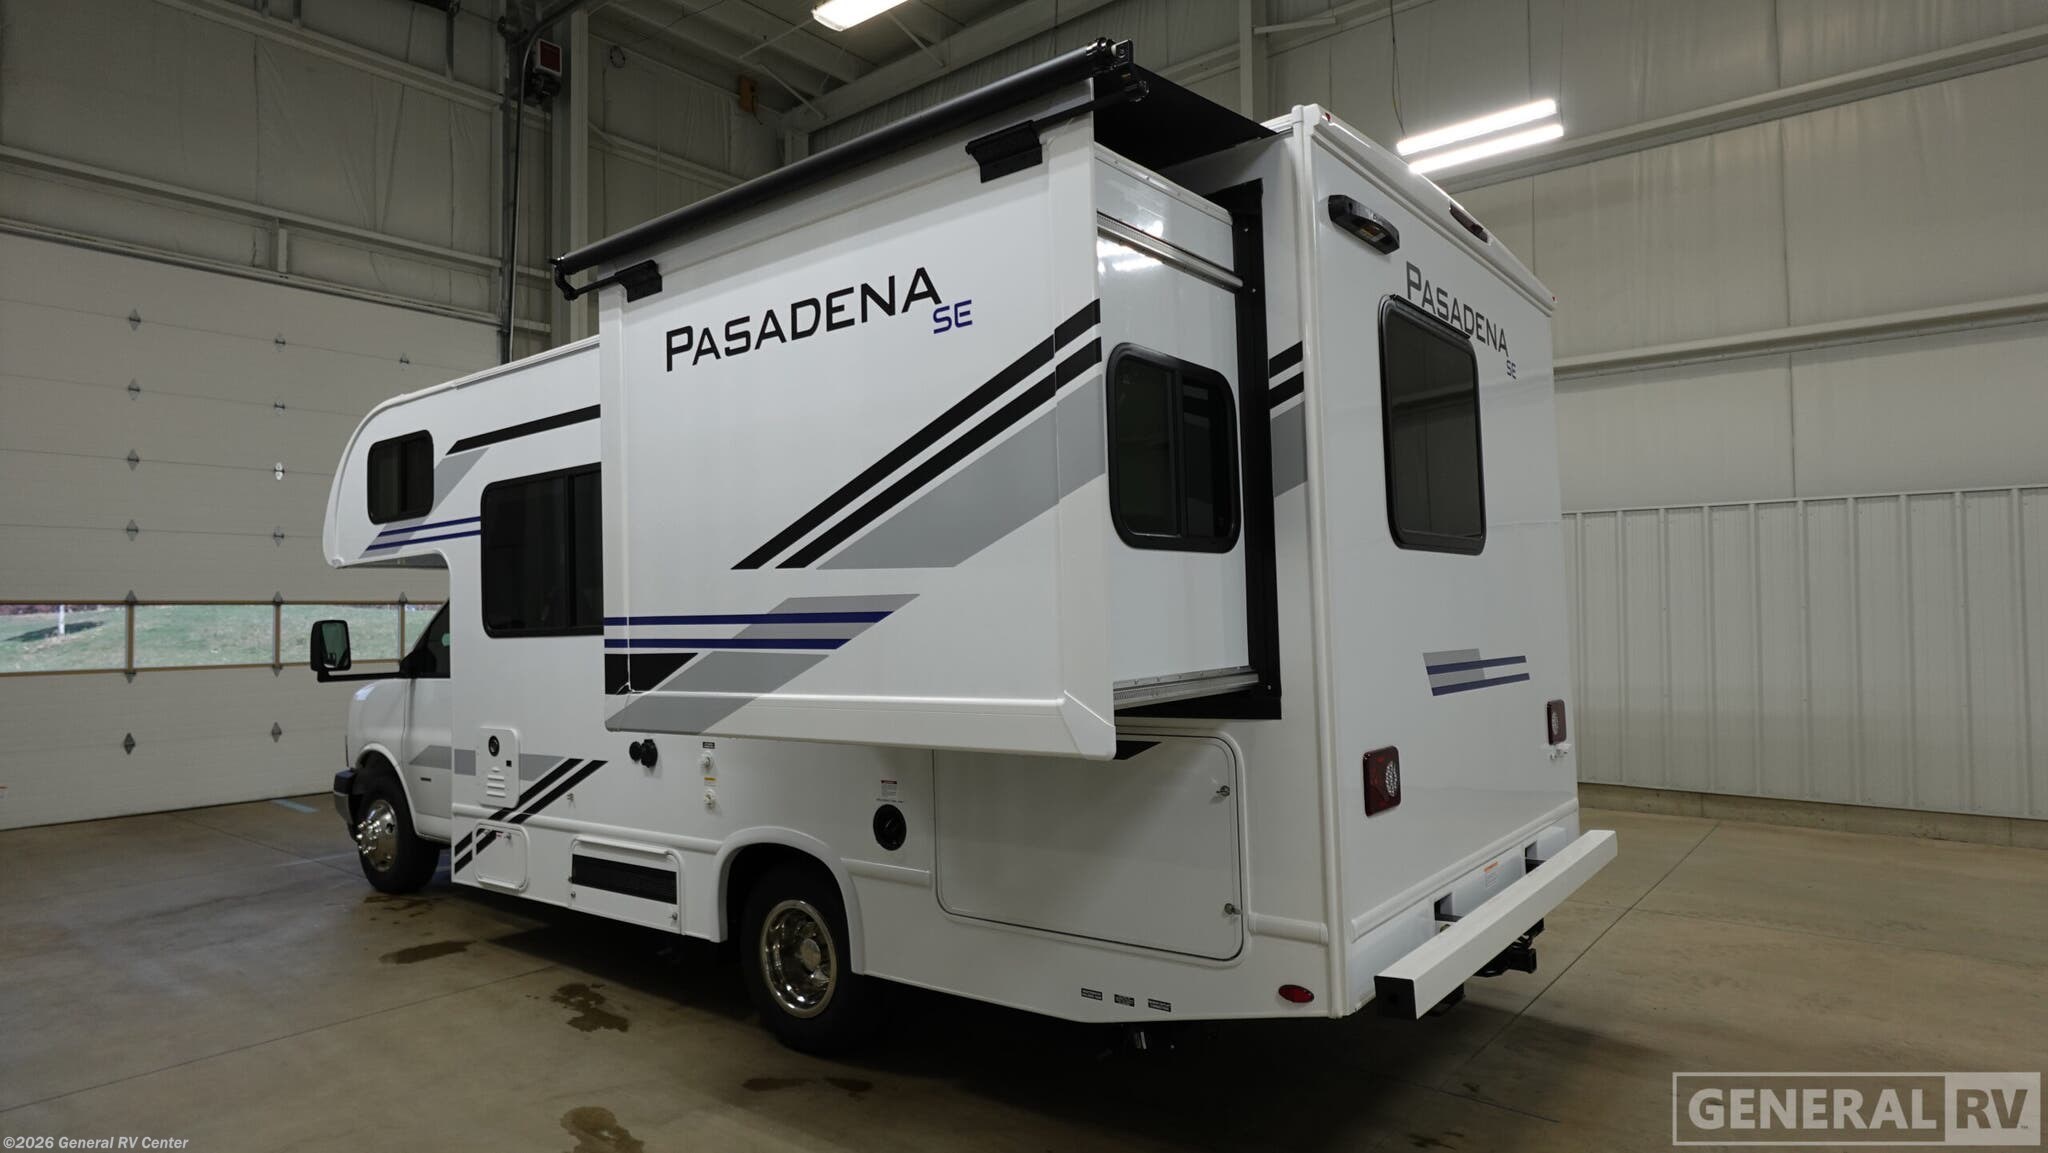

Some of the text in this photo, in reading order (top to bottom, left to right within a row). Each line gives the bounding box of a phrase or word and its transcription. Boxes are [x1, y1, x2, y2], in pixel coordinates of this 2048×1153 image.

[666, 266, 973, 372] PASADENA SE
[1406, 261, 1517, 380] PASADENA SE
